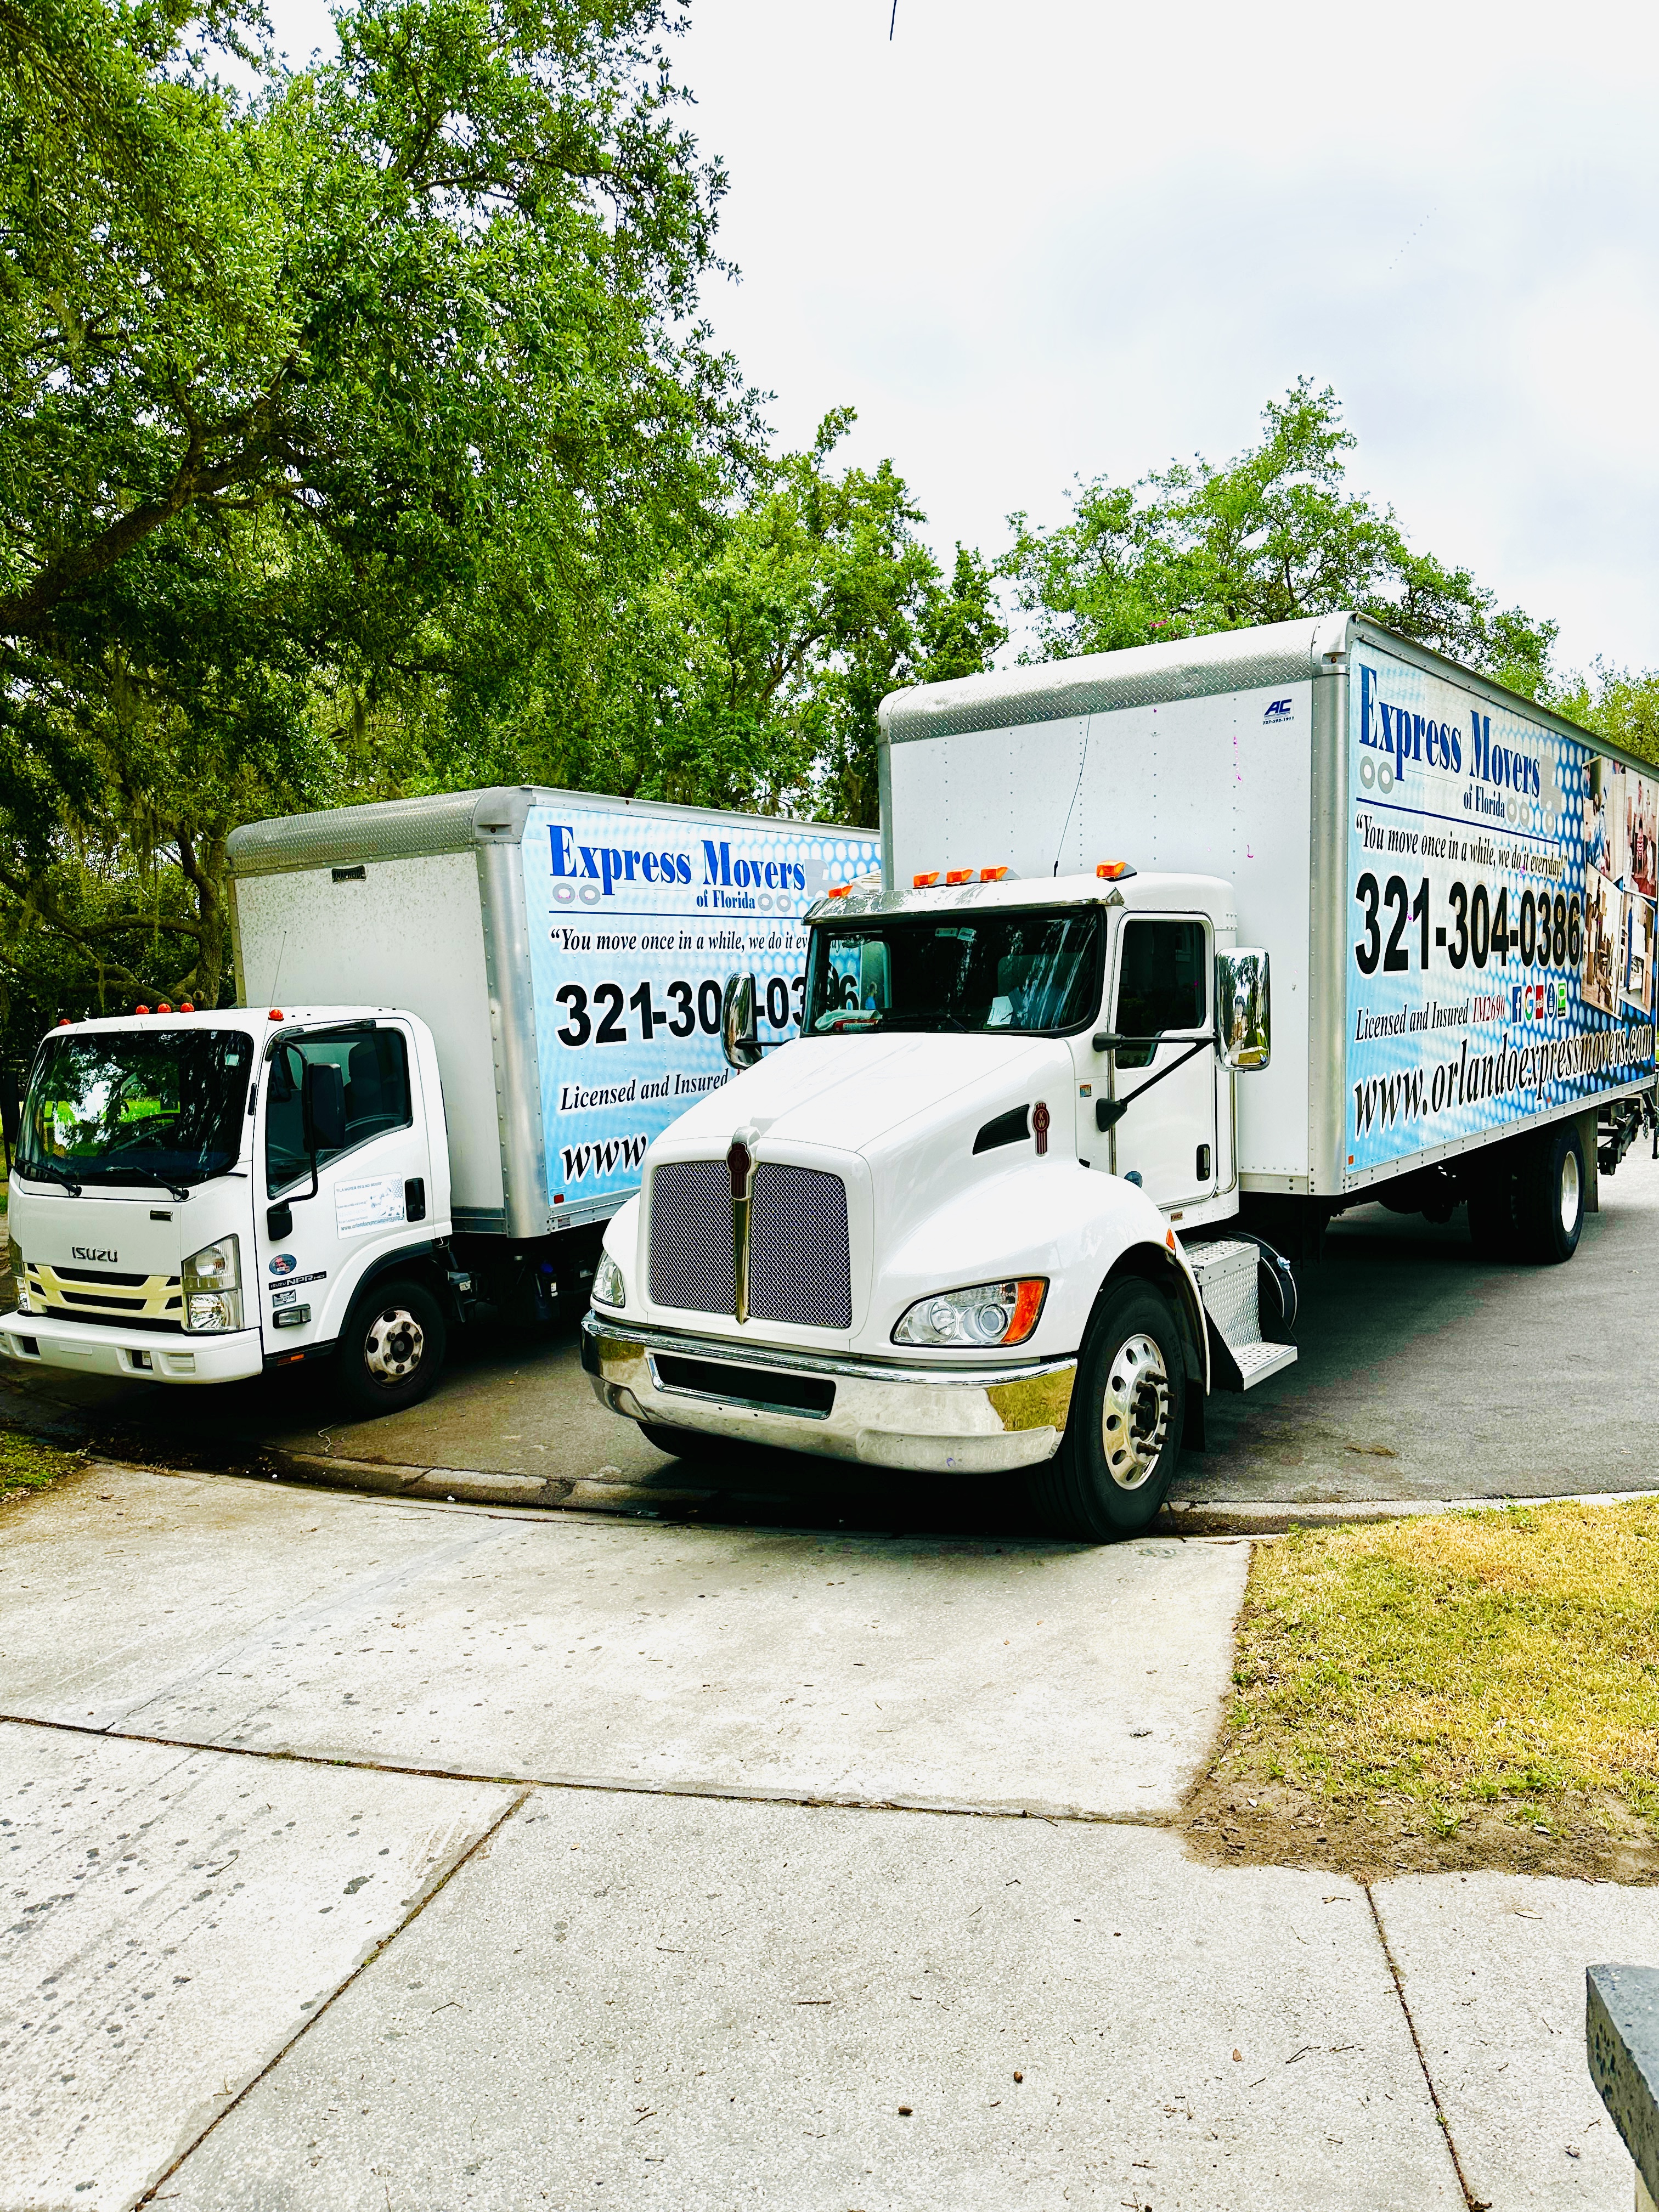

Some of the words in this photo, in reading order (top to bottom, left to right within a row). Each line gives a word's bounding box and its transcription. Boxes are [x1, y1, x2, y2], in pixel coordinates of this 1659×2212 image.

[1265, 699, 1292, 715] AC
[1359, 663, 1462, 782] Express
[1469, 710, 1540, 798] Movers
[1464, 783, 1472, 809] of
[1476, 786, 1505, 818] Florida
[546, 825, 692, 895] Express
[701, 840, 806, 890] Movers
[1356, 814, 1384, 850] “You
[1388, 830, 1418, 854] move
[1421, 836, 1446, 858] once
[1448, 831, 1458, 860] in
[1461, 842, 1468, 861] a
[1470, 837, 1496, 871] while,
[1499, 849, 1510, 868] we
[1511, 844, 1521, 870] do
[1523, 846, 1529, 871] it
[697, 889, 709, 907] of
[713, 890, 755, 909] Florida
[551, 929, 591, 950] “You
[596, 935, 636, 950] move
[641, 936, 674, 950] once
[679, 930, 692, 949] in
[696, 936, 704, 949] a
[708, 931, 744, 953] while,
[749, 936, 765, 949] we
[768, 932, 782, 949] do
[785, 932, 793, 949] it
[1355, 873, 1580, 974] 321-304-0386
[1355, 1004, 1407, 1041] Licensed
[1409, 1002, 1430, 1032] and
[1431, 998, 1469, 1029] Insured
[1472, 995, 1505, 1023] IM2690
[560, 1079, 636, 1111] Licensed
[641, 1075, 669, 1099] and
[674, 1068, 729, 1094] Insured
[1354, 1024, 1652, 1138] www.orlandoexpressmovers.com
[72, 1246, 117, 1262] ISUZU
[286, 1275, 313, 1285] NPR
